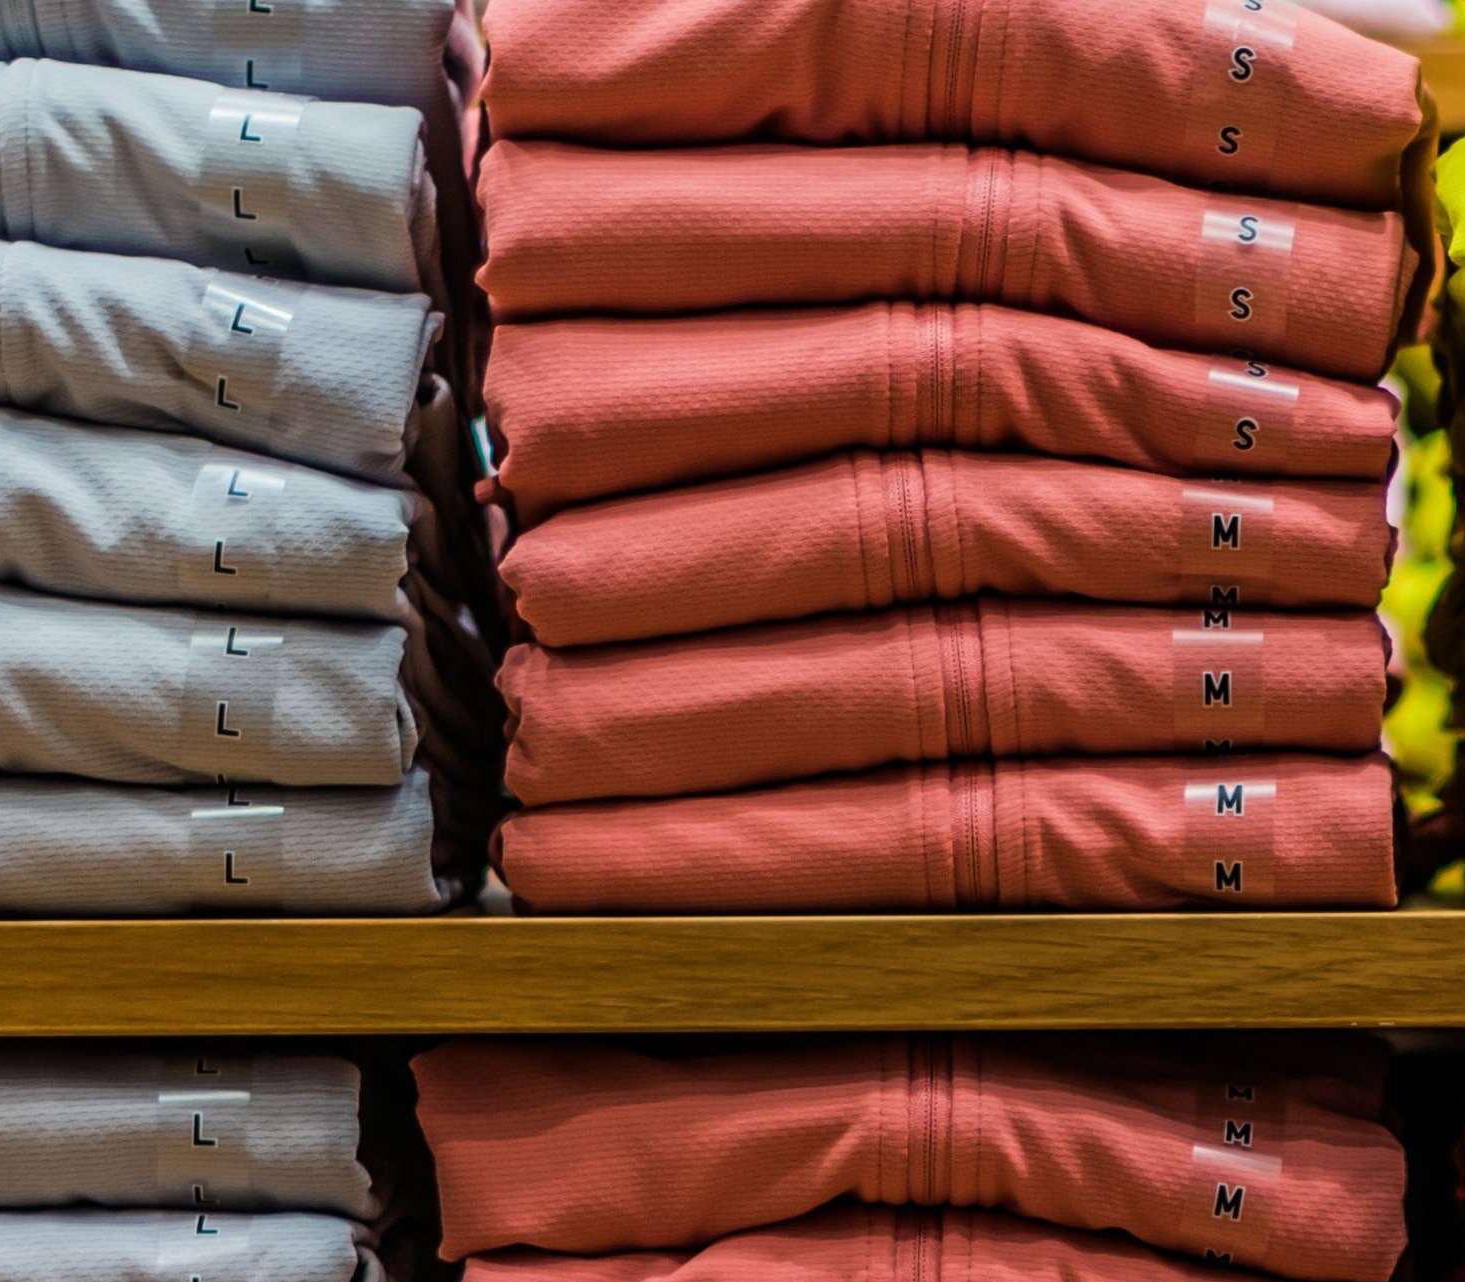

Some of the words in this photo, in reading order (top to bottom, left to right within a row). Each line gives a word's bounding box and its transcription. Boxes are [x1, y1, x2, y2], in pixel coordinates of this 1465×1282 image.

[247, 61, 268, 88] L
[1230, 48, 1254, 81] S
[241, 116, 261, 141] L
[1219, 127, 1239, 154] S
[234, 189, 256, 219] L
[1238, 217, 1258, 241] S
[232, 304, 254, 333] L
[1230, 288, 1252, 320] S
[218, 378, 238, 409] L
[1234, 420, 1258, 450] S
[229, 471, 248, 496] L
[1212, 514, 1240, 549] M
[215, 542, 236, 574] L
[1204, 611, 1229, 629] M
[226, 628, 248, 655] L
[1204, 673, 1230, 706] M
[217, 703, 239, 736] L
[1217, 785, 1243, 815] M
[226, 853, 248, 883] L
[1216, 862, 1241, 892] M
[197, 1059, 219, 1075] L
[193, 1113, 217, 1146] L
[1225, 1121, 1252, 1146] M
[1214, 1184, 1244, 1220] M
[196, 1215, 218, 1234] L
